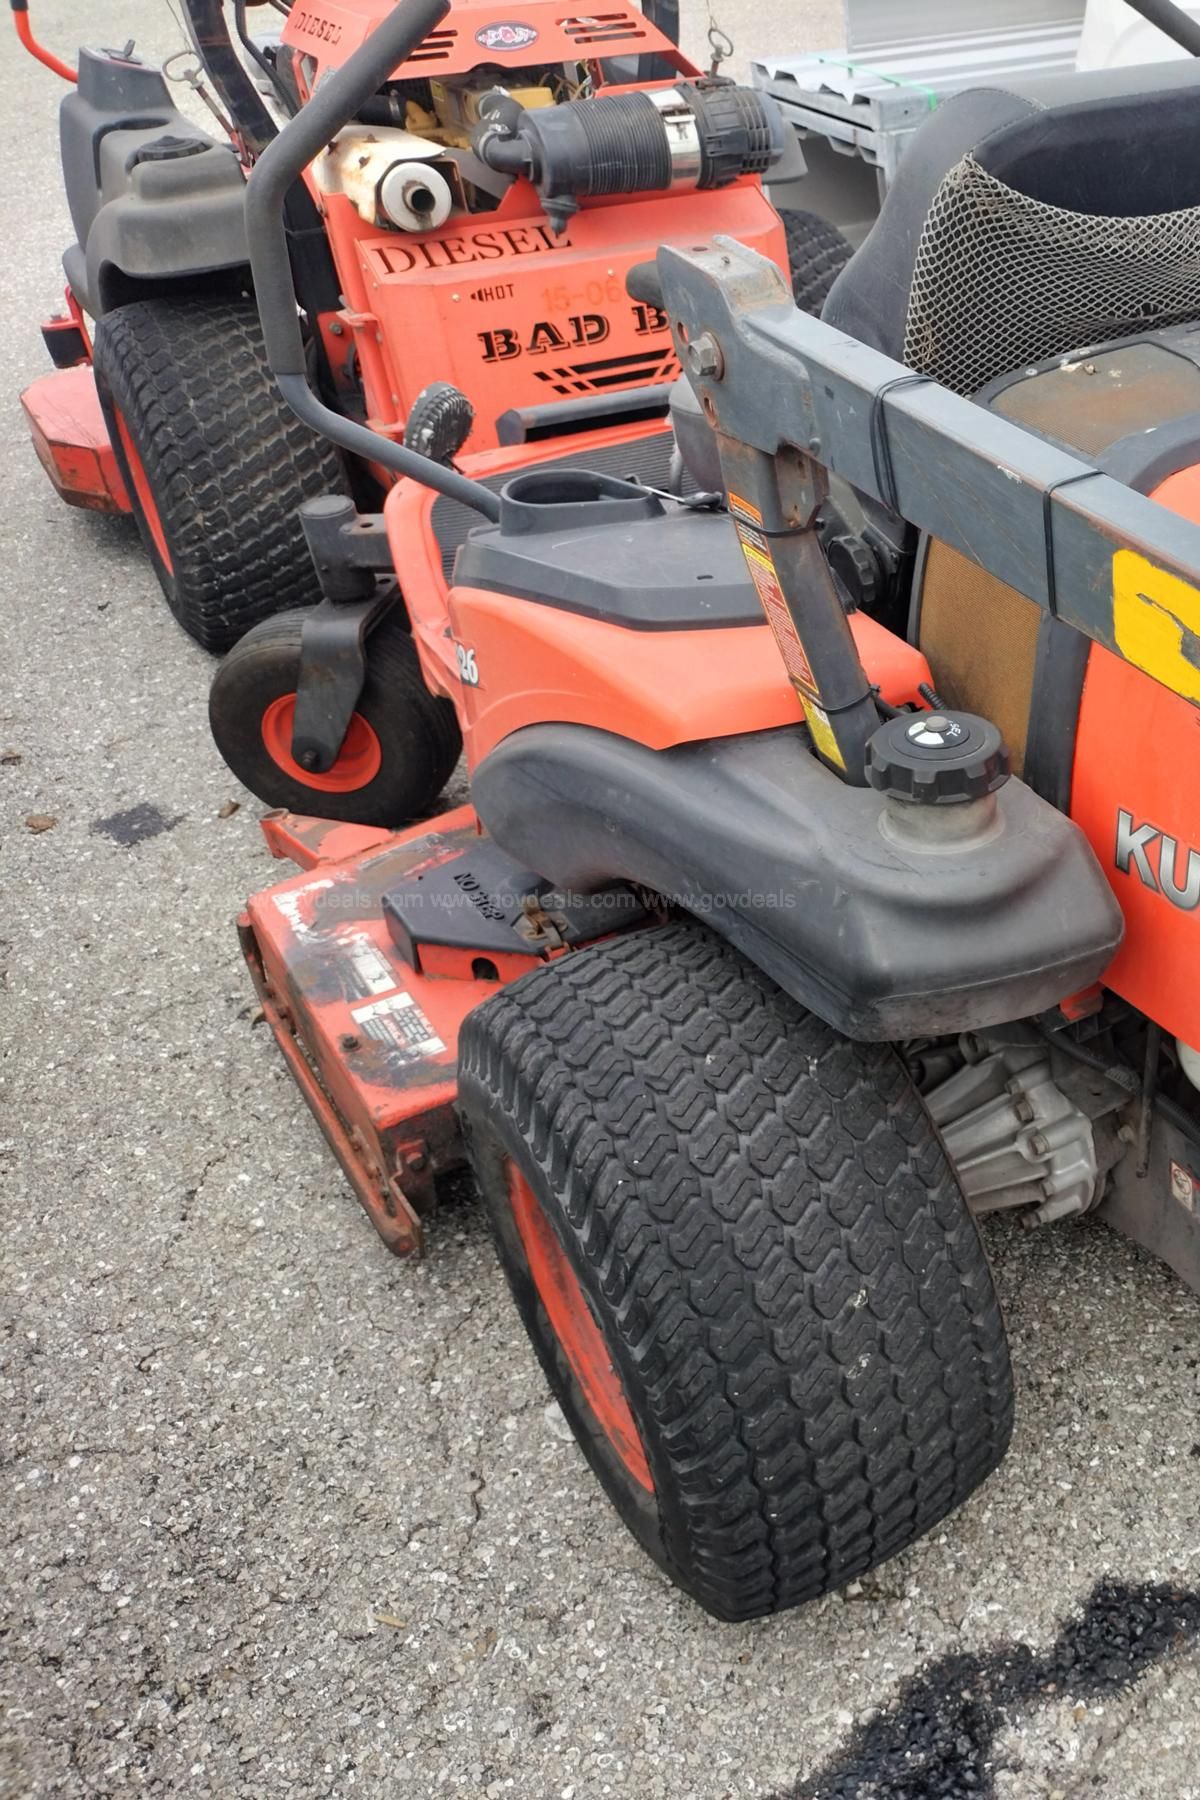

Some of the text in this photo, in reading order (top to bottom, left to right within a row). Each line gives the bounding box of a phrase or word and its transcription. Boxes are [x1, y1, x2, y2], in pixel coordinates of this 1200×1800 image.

[294, 11, 343, 46] DIESEL
[370, 225, 573, 275] DIESEL
[482, 283, 515, 302] HOT
[477, 313, 611, 363] BAD
[453, 872, 481, 892] NO
